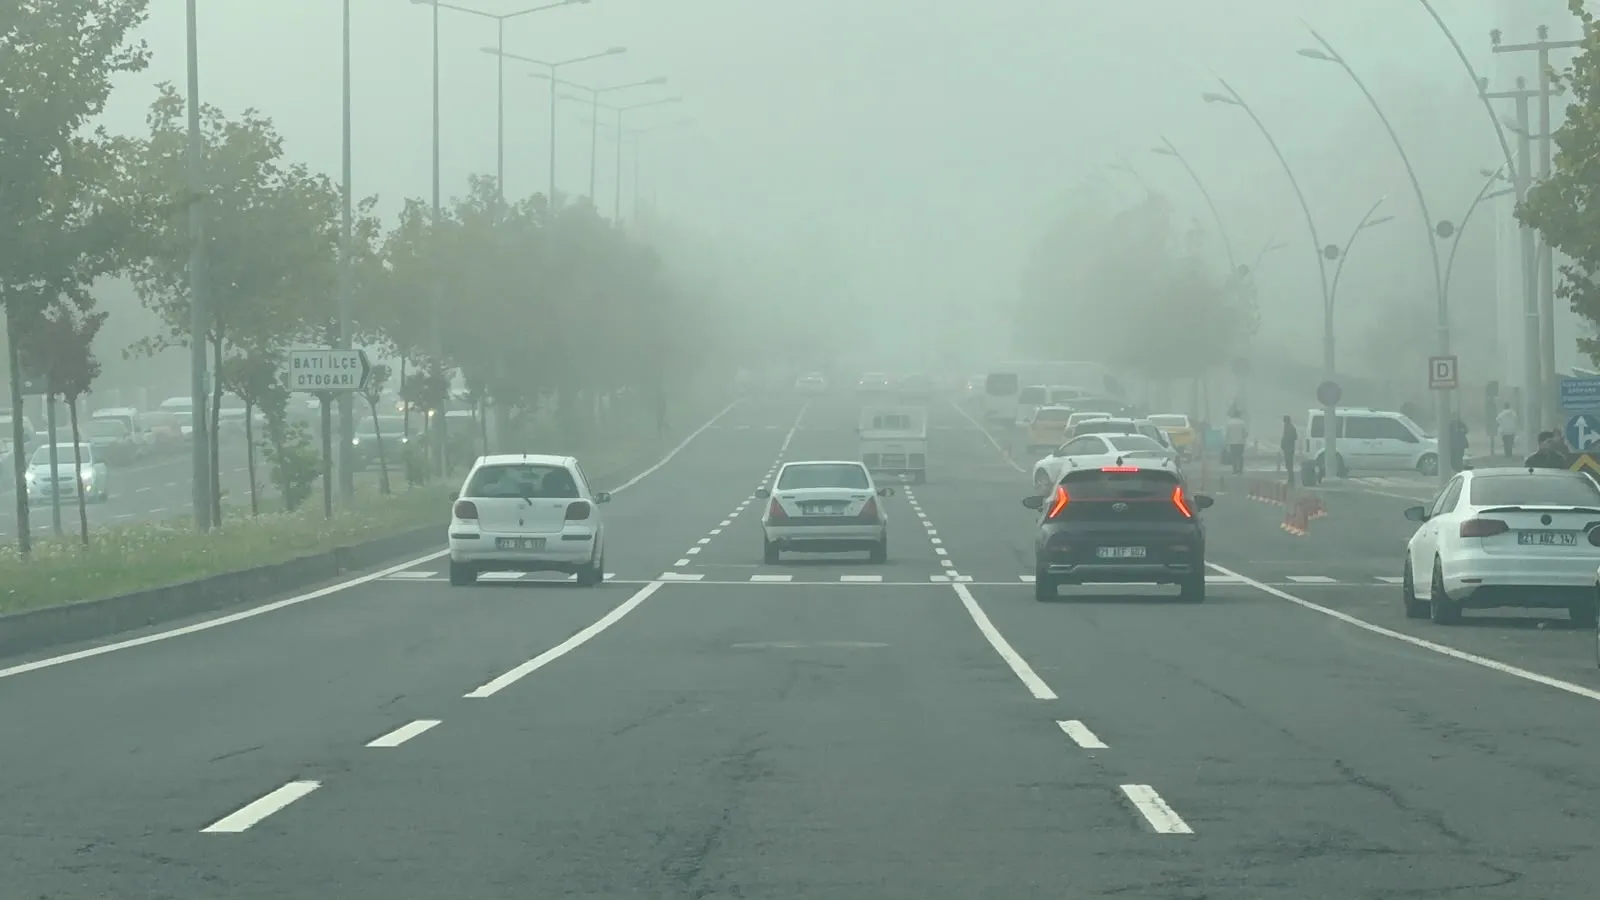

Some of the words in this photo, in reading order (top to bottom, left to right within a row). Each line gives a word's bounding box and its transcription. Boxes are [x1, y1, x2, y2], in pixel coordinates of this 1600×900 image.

[294, 357, 323, 369] BATI
[328, 353, 357, 370] İLÇE
[1437, 363, 1449, 378] D
[298, 374, 354, 385] OTOGARI
